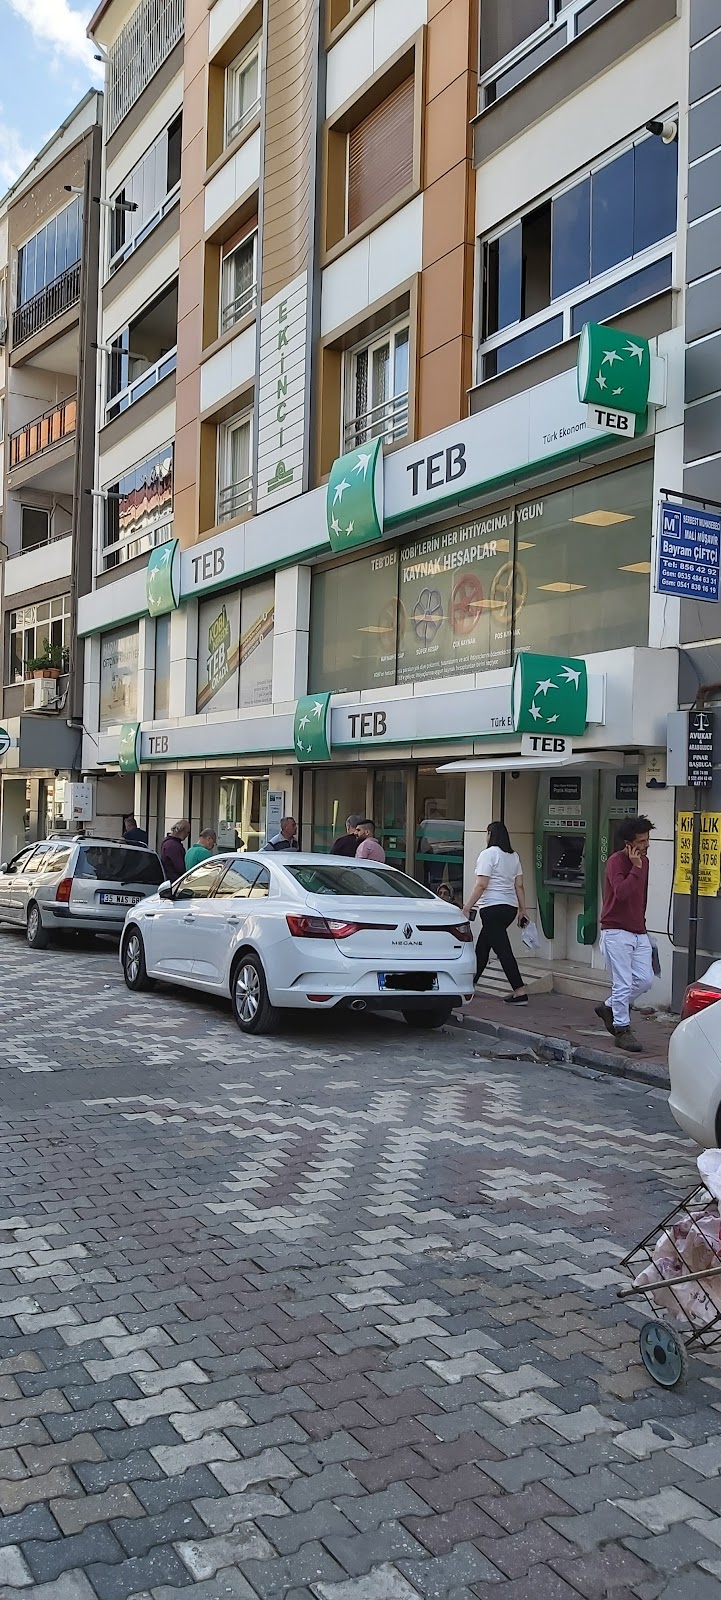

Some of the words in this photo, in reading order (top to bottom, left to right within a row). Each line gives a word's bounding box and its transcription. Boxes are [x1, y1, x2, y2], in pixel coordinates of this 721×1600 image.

[595, 409, 628, 430] TEB
[543, 431, 558, 444] Türk
[406, 442, 467, 496] TEB
[441, 531, 458, 547] HER
[459, 514, 507, 542] İHTİYACINA
[662, 540, 692, 557] Bayram
[693, 544, 718, 564] ÇİFTÇİ
[191, 547, 225, 584] TEB
[402, 556, 441, 583] KAYNAK
[442, 540, 497, 571] HESAPLAR
[662, 560, 678, 568] Tel:
[679, 563, 695, 571] 856
[696, 566, 707, 574] 42
[661, 569, 676, 577] Gsm:
[661, 578, 676, 586] Gsm:
[207, 642, 226, 681] TEB
[348, 711, 387, 738] TEB
[490, 717, 506, 727] Türk
[529, 736, 566, 752] TEB
[689, 732, 712, 740] AVUKAT
[148, 736, 169, 754] TEB
[701, 839, 710, 850] 65
[710, 839, 718, 850] 72
[680, 853, 690, 864] 535
[702, 853, 710, 864] 17
[710, 853, 718, 865] 56
